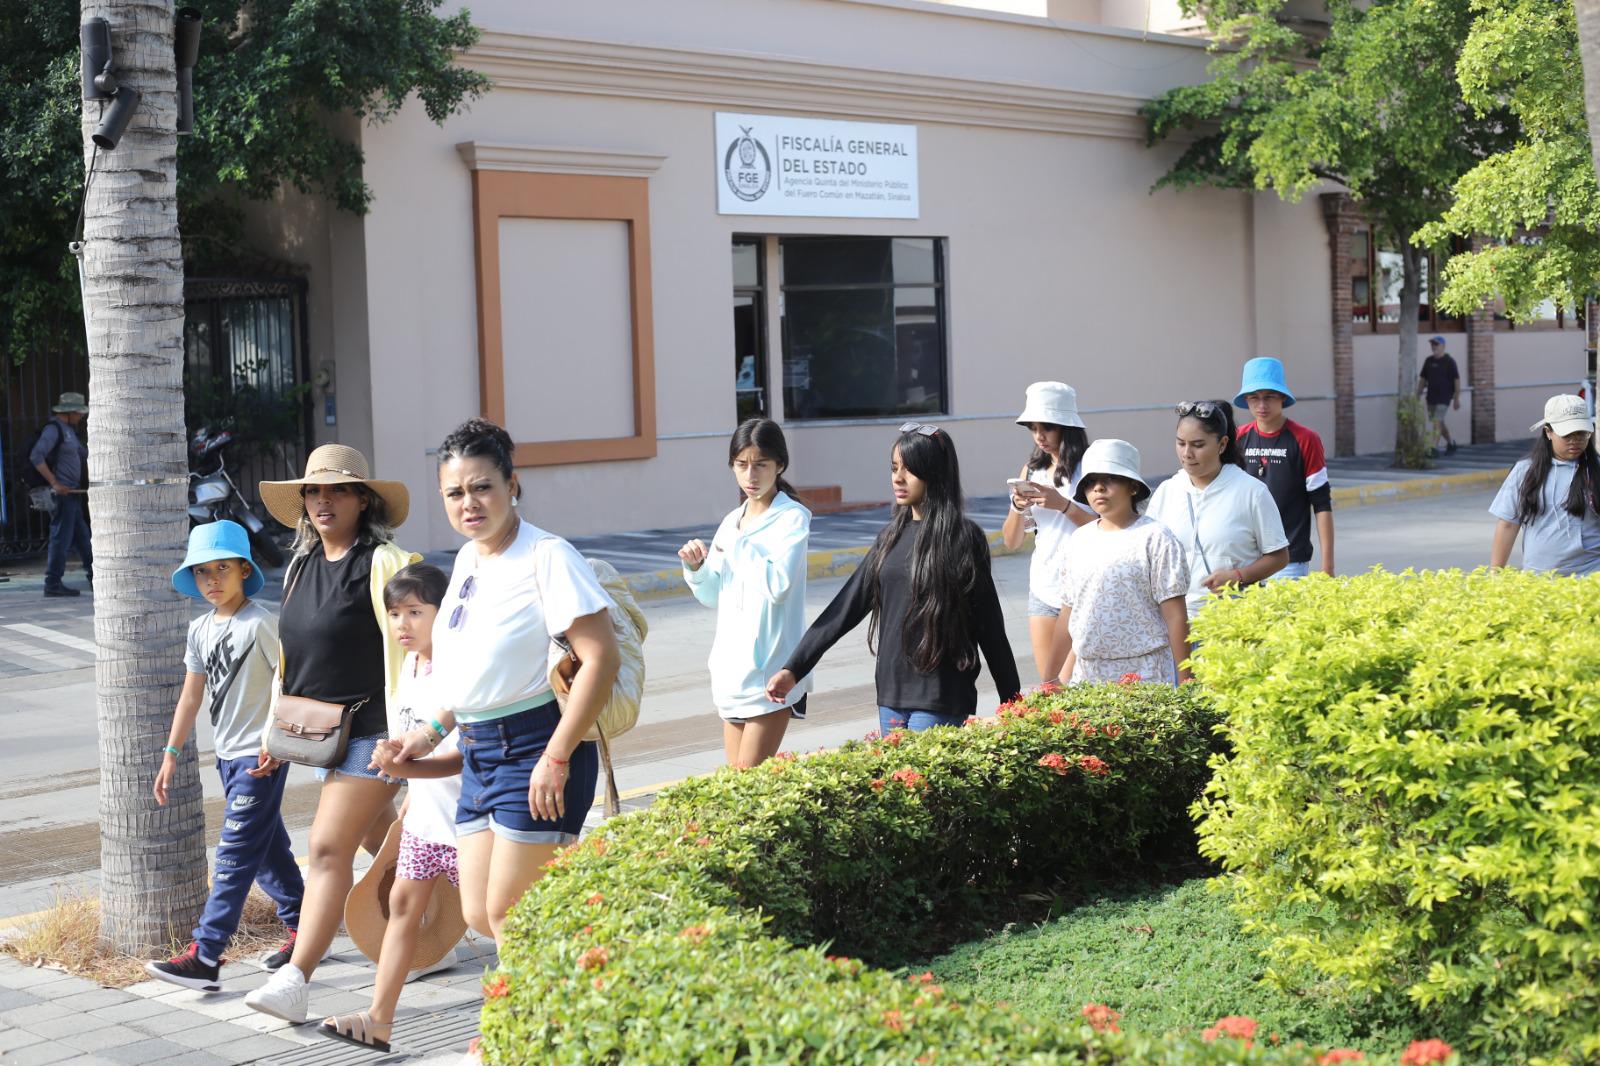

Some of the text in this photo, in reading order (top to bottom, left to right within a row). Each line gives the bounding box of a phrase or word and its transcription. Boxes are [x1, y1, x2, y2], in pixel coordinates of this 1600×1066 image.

[782, 134, 908, 156] FISCALÍA GENERAL
[783, 159, 867, 176] DEL ESTADO
[738, 172, 759, 183] FGE
[783, 176, 812, 187] Agencia
[814, 178, 837, 187] Quinta
[839, 178, 849, 187] del
[851, 179, 882, 189] Ministerio
[783, 188, 796, 198] del
[797, 189, 817, 198] Fuero
[819, 189, 843, 199] Común
[845, 192, 853, 200] en
[1245, 448, 1287, 457] ABERCROMBIE
[234, 794, 257, 805] NIKE
